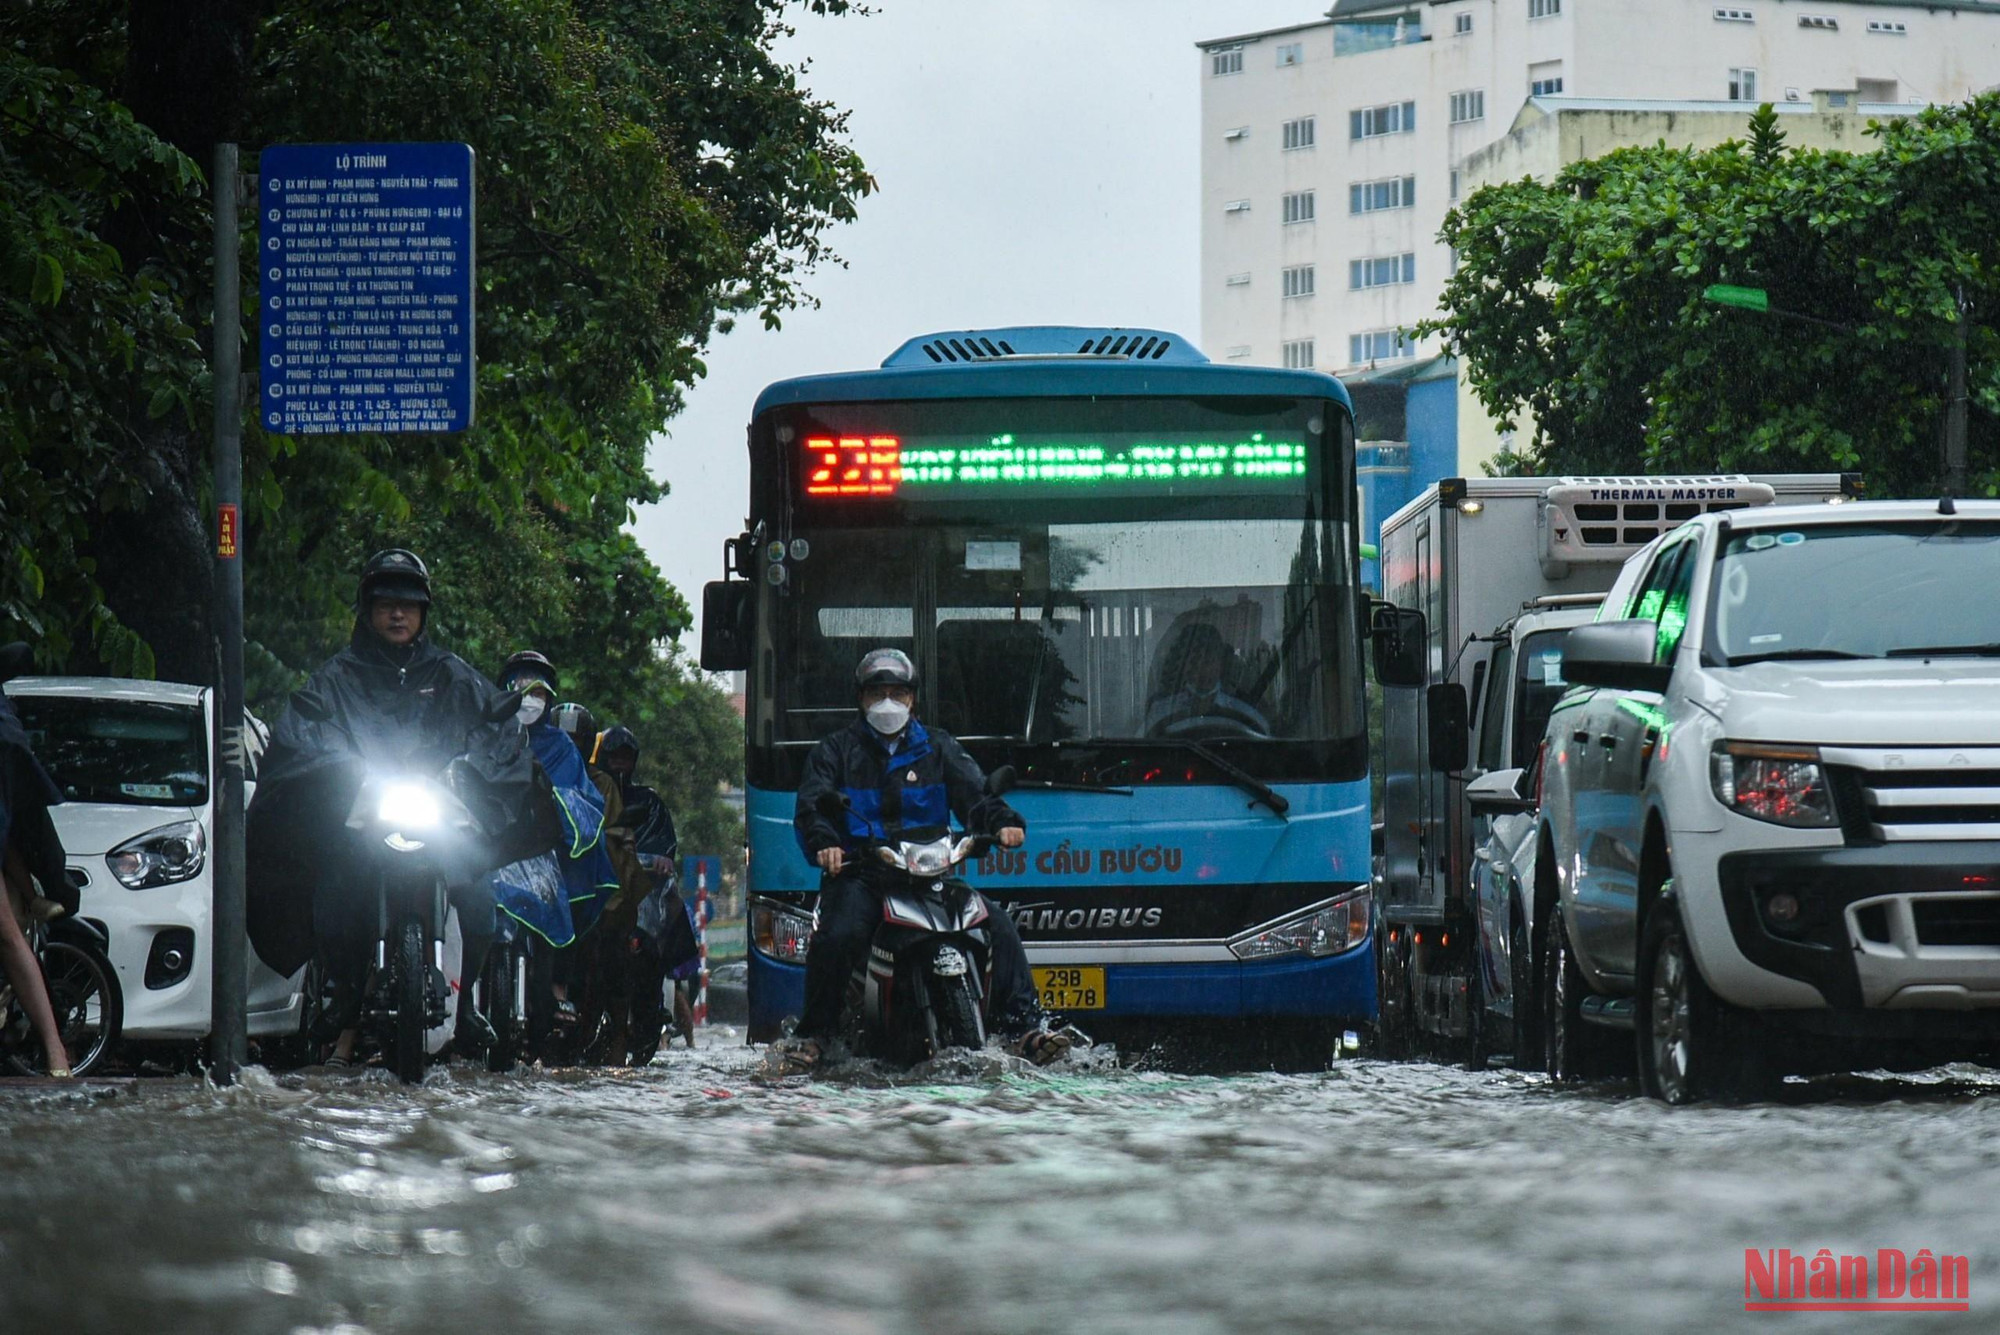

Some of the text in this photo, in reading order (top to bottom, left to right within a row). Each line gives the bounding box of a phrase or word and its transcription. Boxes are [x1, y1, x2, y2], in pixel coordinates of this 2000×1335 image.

[336, 152, 387, 171] LỘ TRÌNH
[286, 179, 296, 189] BX
[339, 208, 349, 218] QL
[351, 208, 356, 218] 6
[282, 223, 297, 233] CHU
[331, 222, 350, 232] LINH
[377, 222, 388, 232] BX
[286, 268, 297, 277] BX
[357, 281, 367, 291] BX
[338, 310, 346, 320] 21
[363, 325, 391, 335] KHANG
[405, 353, 422, 363] LINH
[330, 369, 347, 379] LINH
[374, 368, 394, 378] AEON
[395, 367, 415, 378] MALL
[416, 367, 436, 377] LONG
[328, 401, 337, 411] QL
[365, 400, 373, 410] TL
[376, 400, 391, 410] 425
[285, 413, 295, 423] BX
[342, 412, 351, 422] QL
[353, 411, 363, 421] 1A
[369, 410, 384, 420] CAO
[346, 422, 356, 432] BX
[431, 420, 449, 431] NAM
[1591, 487, 1736, 500] THERMAL MASTER
[978, 850, 1027, 876] BUS
[1045, 970, 1081, 988] 29B
